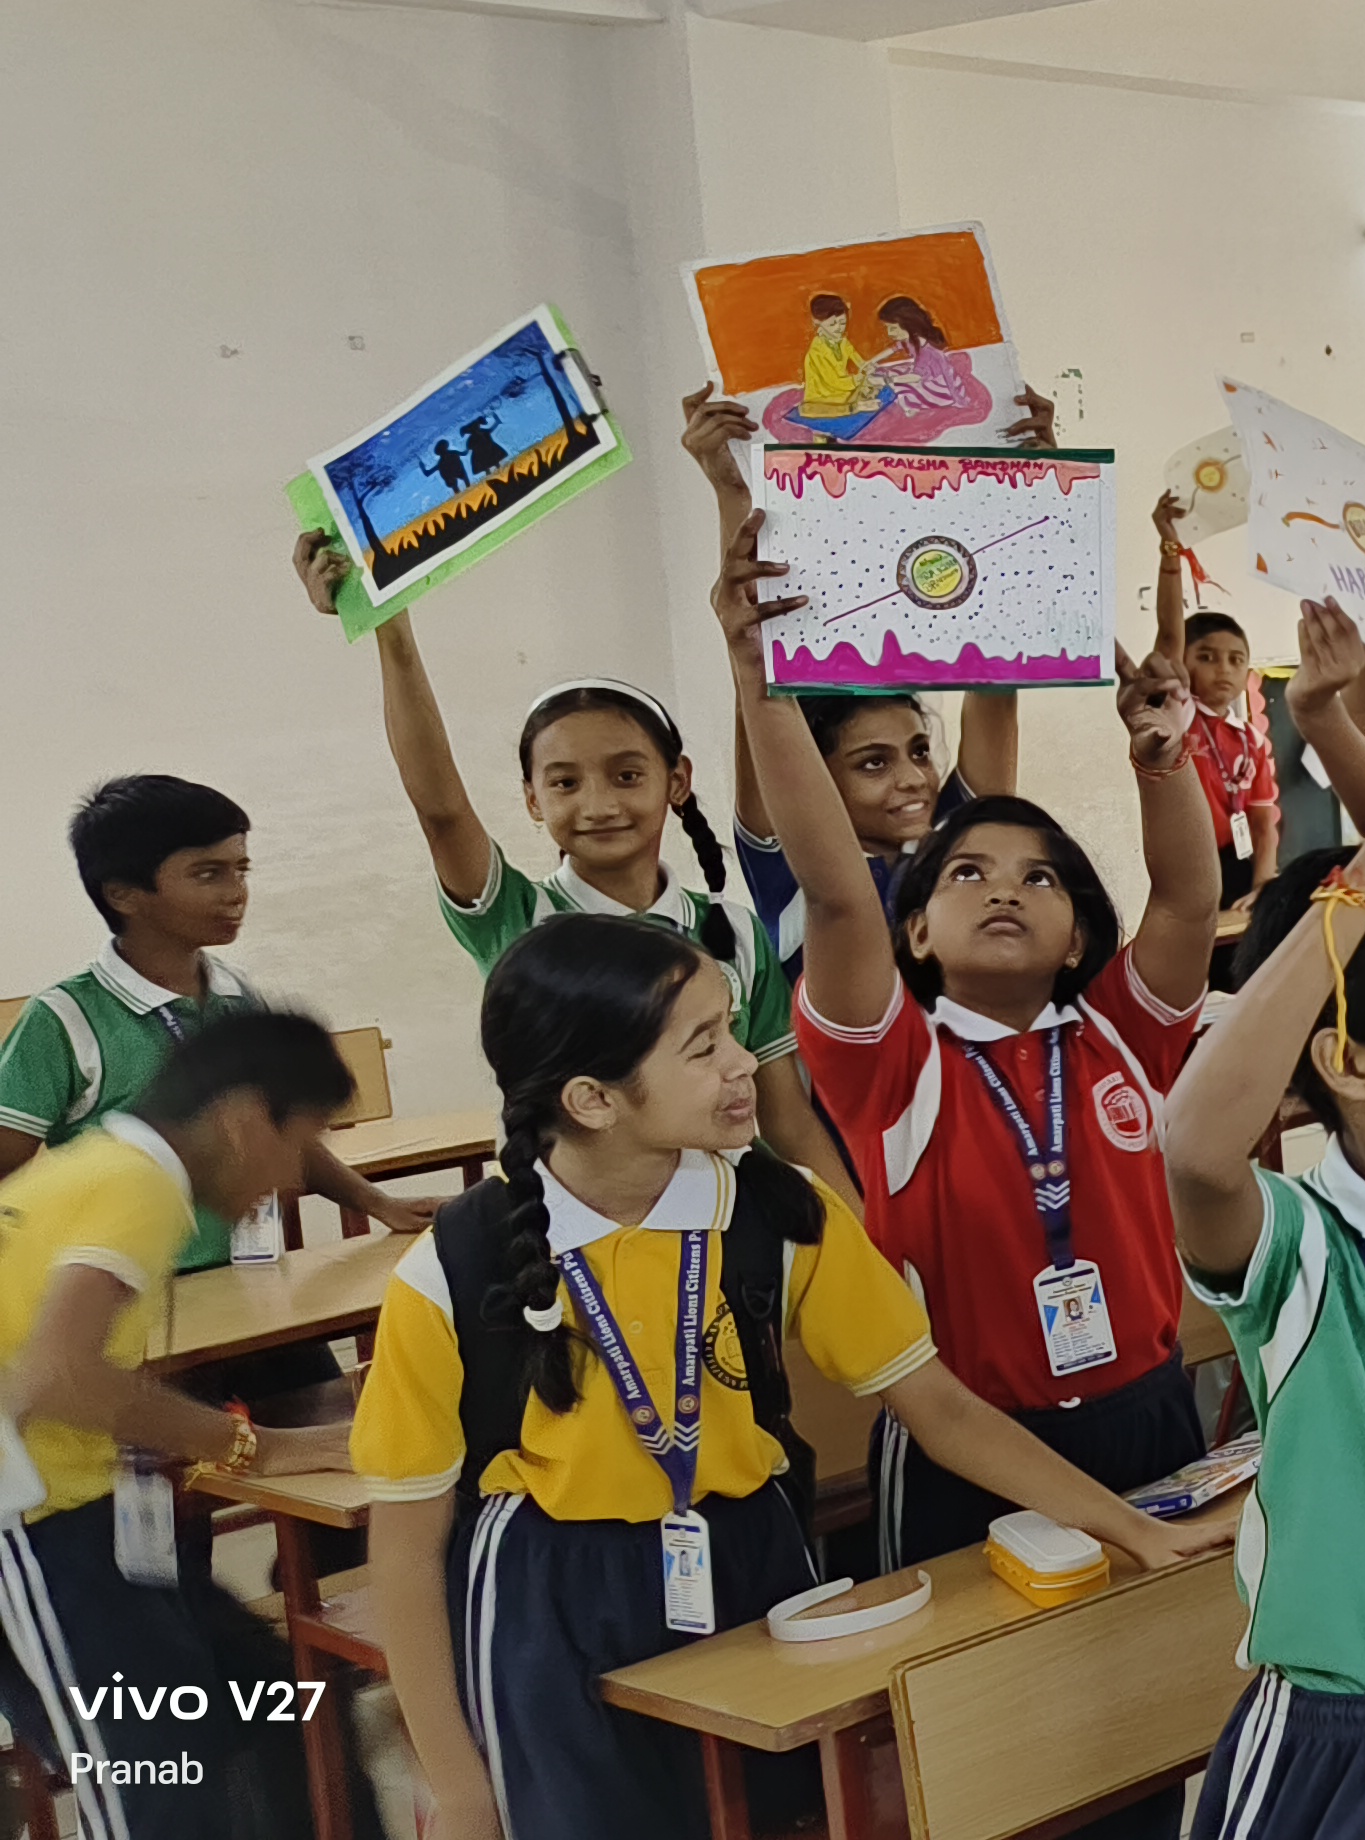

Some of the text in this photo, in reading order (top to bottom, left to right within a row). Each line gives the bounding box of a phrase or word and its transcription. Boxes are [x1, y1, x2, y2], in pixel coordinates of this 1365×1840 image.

[803, 451, 871, 474] HAPPY
[877, 456, 950, 472] RAKSHA
[1010, 1110, 1039, 1156] Amarpati
[1050, 1104, 1065, 1153] Amarpati
[685, 1244, 702, 1292] Citizens
[571, 1269, 601, 1315] Citizens
[683, 1294, 699, 1327] Lions
[595, 1314, 617, 1347] Lions
[607, 1346, 642, 1400] Amarpati
[682, 1328, 699, 1387] Amarpati
